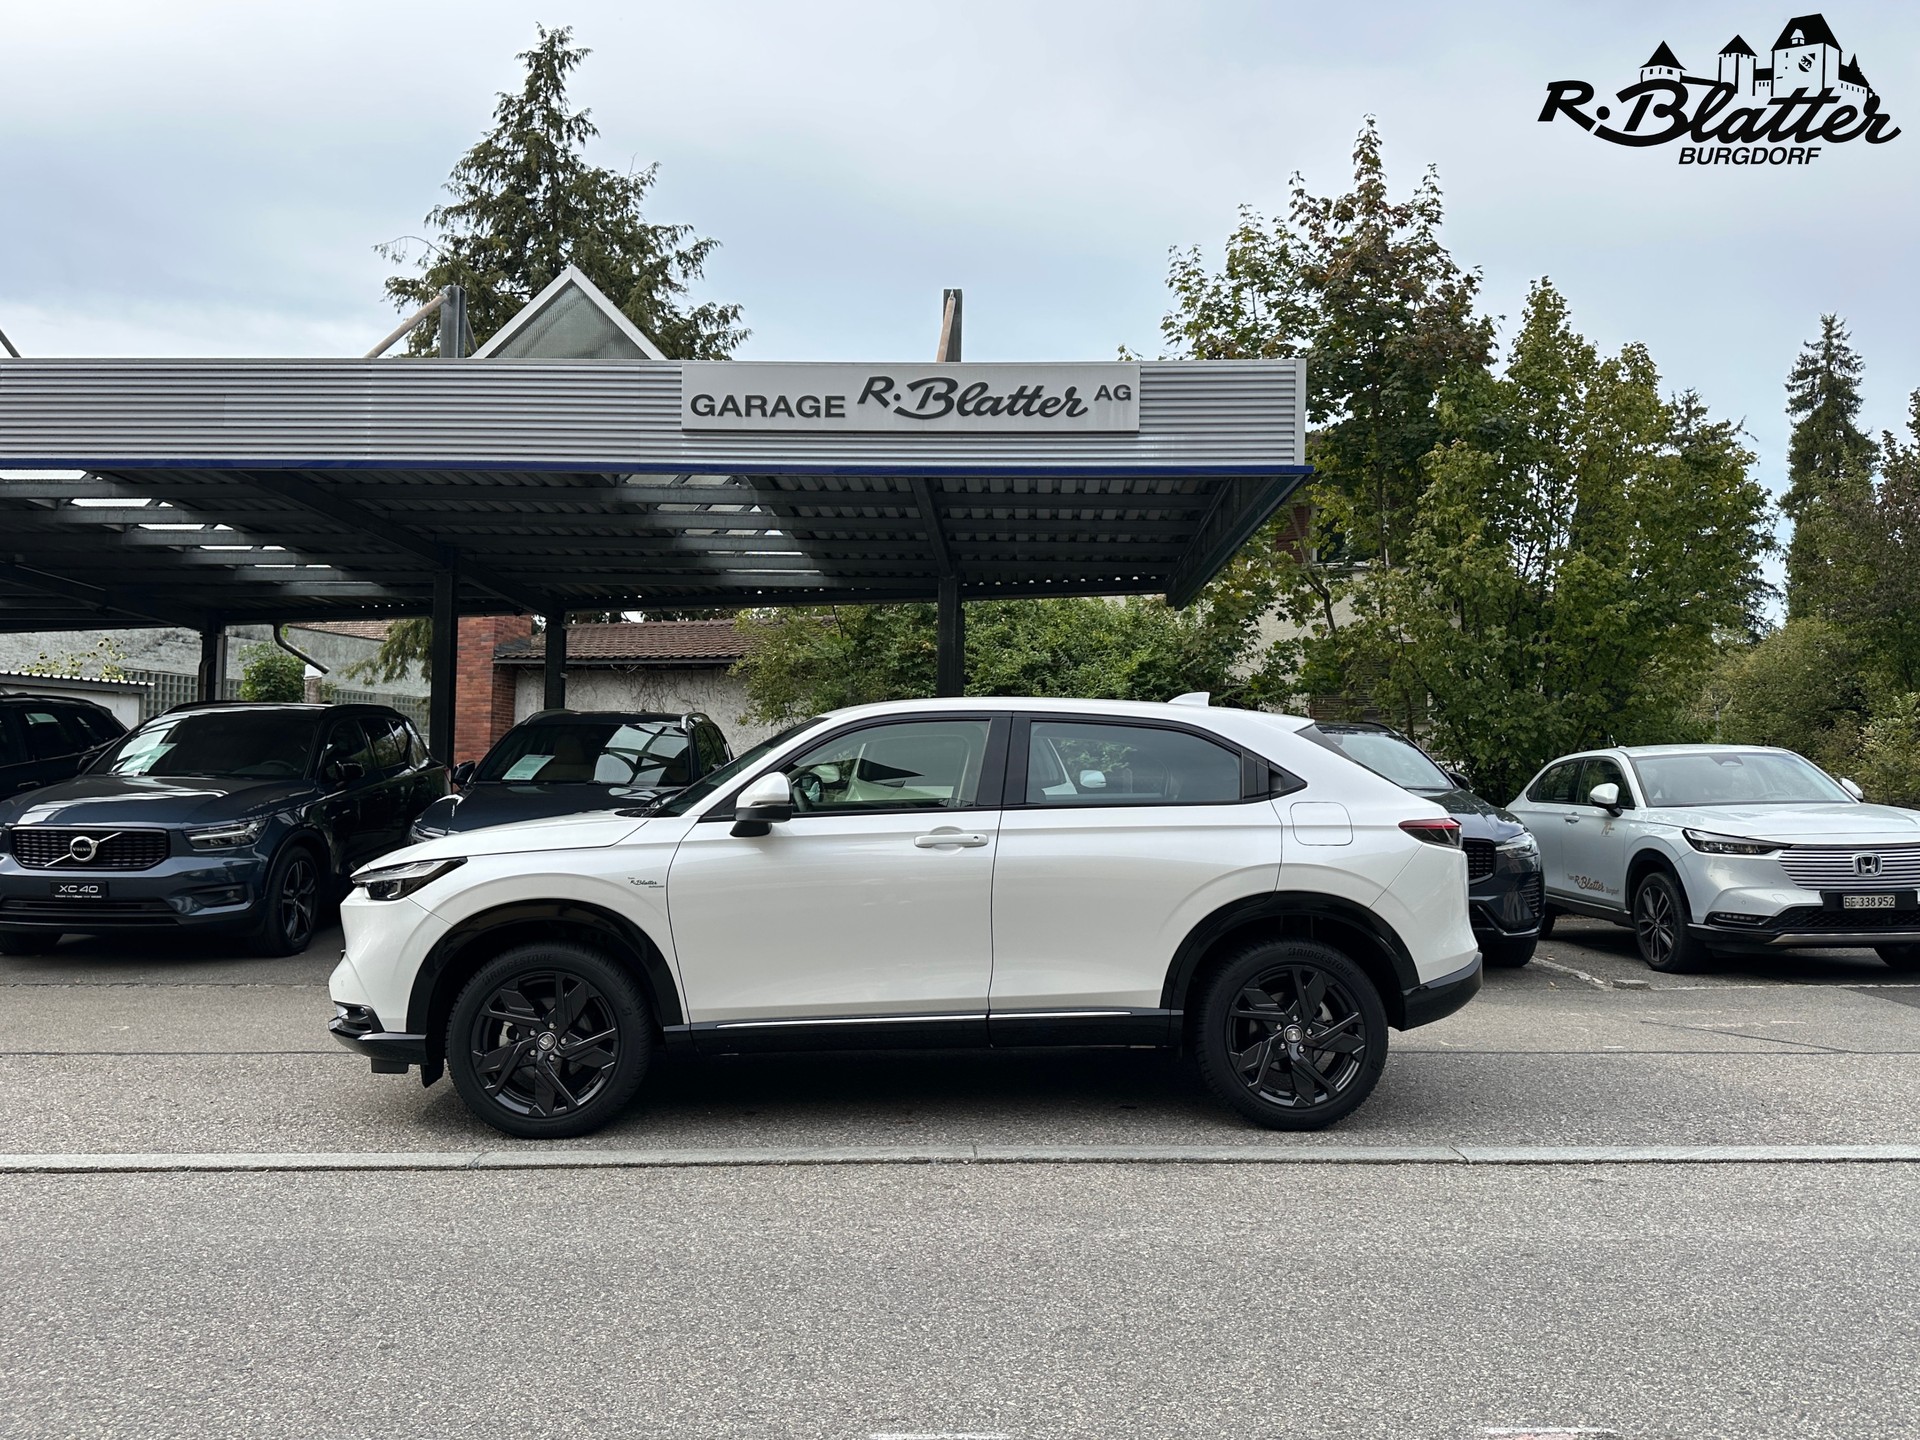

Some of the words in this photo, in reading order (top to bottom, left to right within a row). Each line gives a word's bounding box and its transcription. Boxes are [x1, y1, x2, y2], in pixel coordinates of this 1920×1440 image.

[690, 394, 846, 418] GARAGE
[1094, 384, 1132, 402] AG
[59, 885, 78, 893] XC
[79, 885, 99, 893] 40
